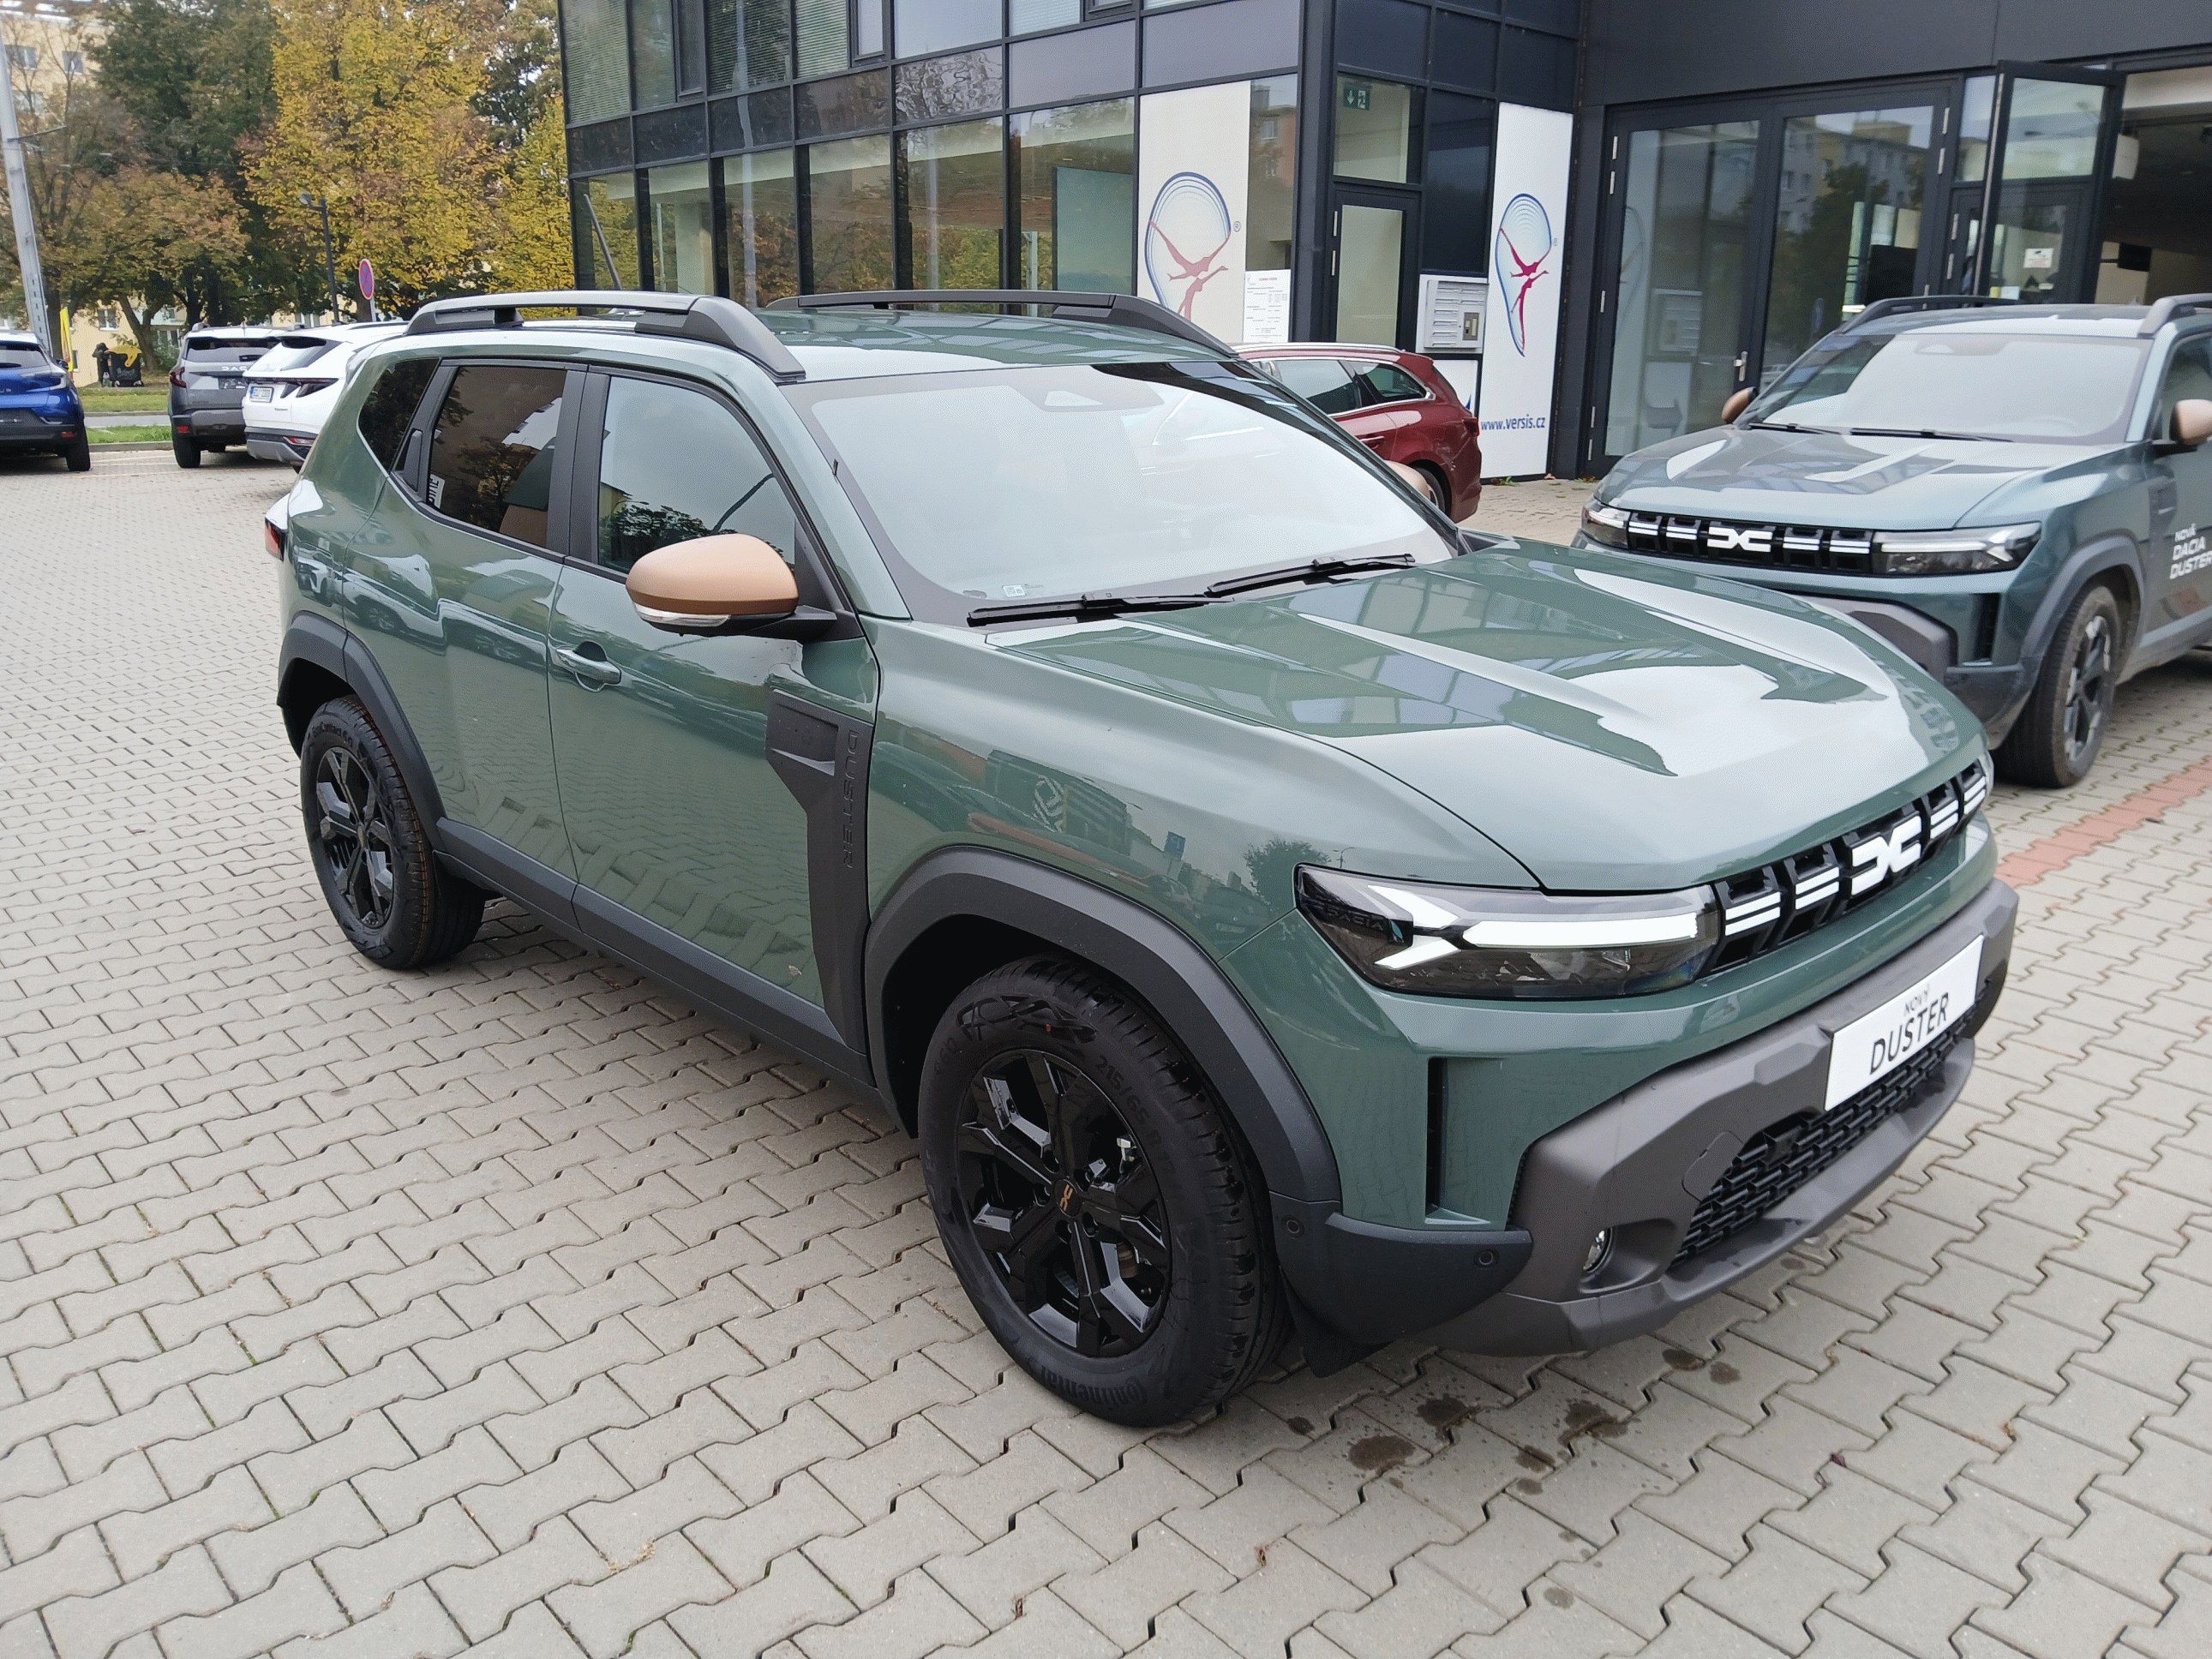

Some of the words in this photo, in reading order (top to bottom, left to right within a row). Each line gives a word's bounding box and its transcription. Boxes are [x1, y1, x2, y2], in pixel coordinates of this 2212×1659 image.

[1479, 413, 1546, 431] www.versis.cz
[2169, 550, 2212, 580] DUSTER
[842, 729, 860, 869] DUSTER
[1869, 991, 1950, 1075] DUSTER
